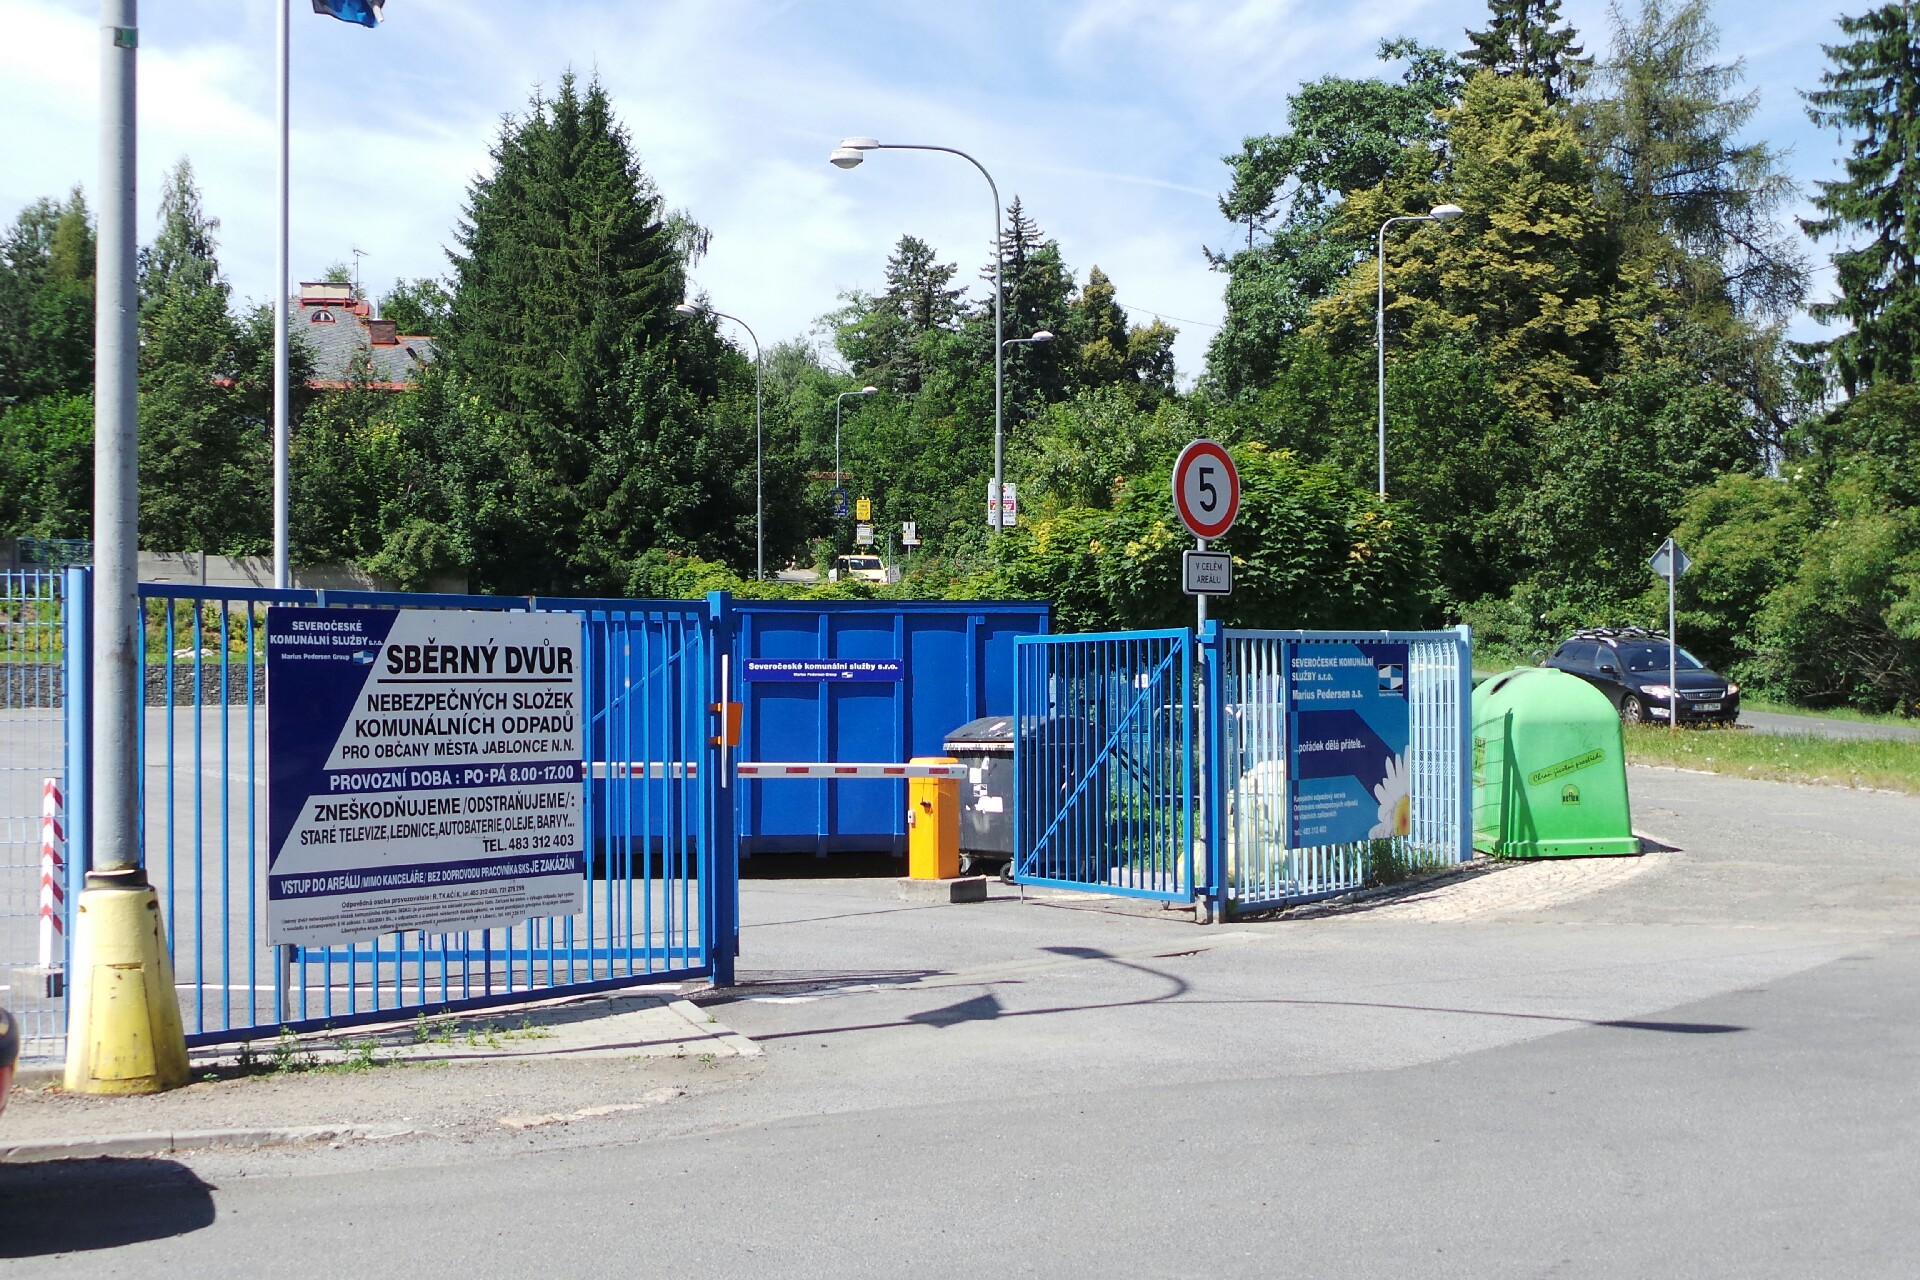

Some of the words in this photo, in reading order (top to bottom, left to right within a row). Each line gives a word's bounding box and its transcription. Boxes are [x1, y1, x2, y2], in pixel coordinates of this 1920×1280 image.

[1198, 467, 1217, 512] 5
[1196, 563, 1200, 571] V
[1202, 560, 1222, 571] CELÉM
[1197, 573, 1221, 584] AREÁLU
[292, 620, 362, 631] SEVEROČESKÉ
[270, 633, 330, 645] KOMUNÁLNÍ
[332, 635, 368, 645] SLUŽBY
[387, 637, 498, 674] SBĚRNÝ
[505, 638, 573, 674] DVŮR
[1292, 656, 1338, 668] SEVEROČESKÉ
[1339, 656, 1374, 666] KOMUNÁLNÍ
[748, 662, 802, 670] Severočeské
[804, 662, 847, 670] komunální
[850, 662, 876, 671] služby
[1292, 670, 1316, 681] SLUŽBY
[368, 688, 507, 712] NEBEZPEČNÝCH
[512, 688, 574, 709] SLOŽEK
[1292, 690, 1315, 700] Marius
[1317, 689, 1350, 699] Pedersen
[356, 713, 494, 738] KOMUNÁLNÍCH
[502, 710, 574, 734] ODPADŮ
[342, 745, 370, 760] PRO
[374, 740, 430, 758] OBČANY
[434, 739, 478, 756] MĚSTA
[482, 740, 548, 754] JABLONCE
[1325, 740, 1339, 750] dělá
[330, 768, 406, 790] PROVOZNÍ
[411, 770, 452, 786] DOBA
[314, 795, 460, 822] ZNEŠKODŇUJEME
[300, 824, 336, 845] STARÉ
[483, 839, 506, 852] TEL.
[508, 837, 529, 850] 483
[532, 836, 550, 848] 312
[553, 834, 574, 847] 403
[281, 878, 312, 894] VSTUP
[312, 878, 326, 892] DO
[326, 872, 360, 890] AREÁLU
[428, 872, 440, 882] BEZ
[442, 868, 480, 880] DOPROVODU
[482, 862, 518, 878] PRACOVNÍKA
[530, 860, 539, 872] JE
[540, 855, 574, 872] ZAKÁZÁN
